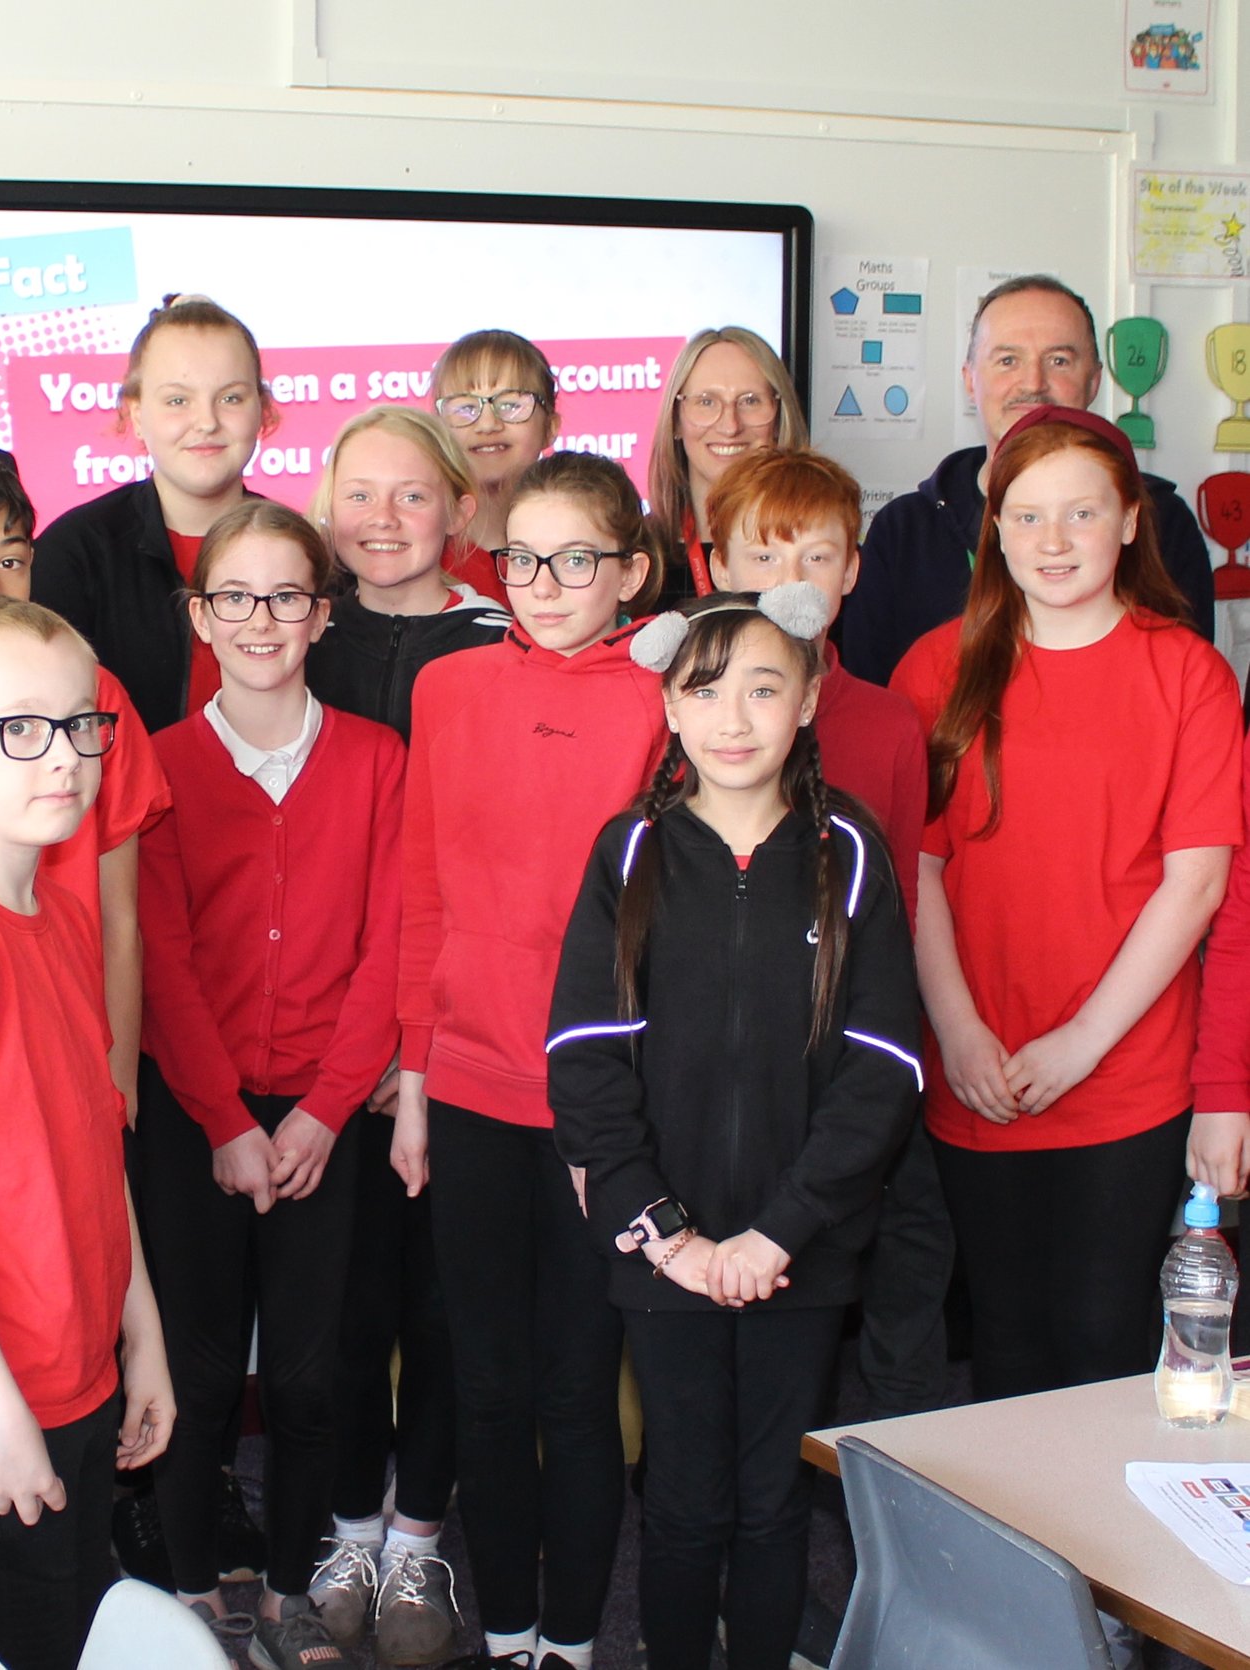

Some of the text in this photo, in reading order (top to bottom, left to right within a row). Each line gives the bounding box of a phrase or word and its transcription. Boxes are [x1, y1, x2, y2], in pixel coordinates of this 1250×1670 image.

[1169, 178, 1182, 194] of
[1185, 179, 1205, 195] the
[1208, 180, 1247, 196] Week
[859, 261, 893, 274] Maths
[856, 279, 895, 292] Groups
[1127, 345, 1146, 367] 26
[1232, 349, 1247, 375] 18
[40, 373, 123, 412] You
[330, 372, 356, 400] a
[1221, 500, 1243, 522] 43
